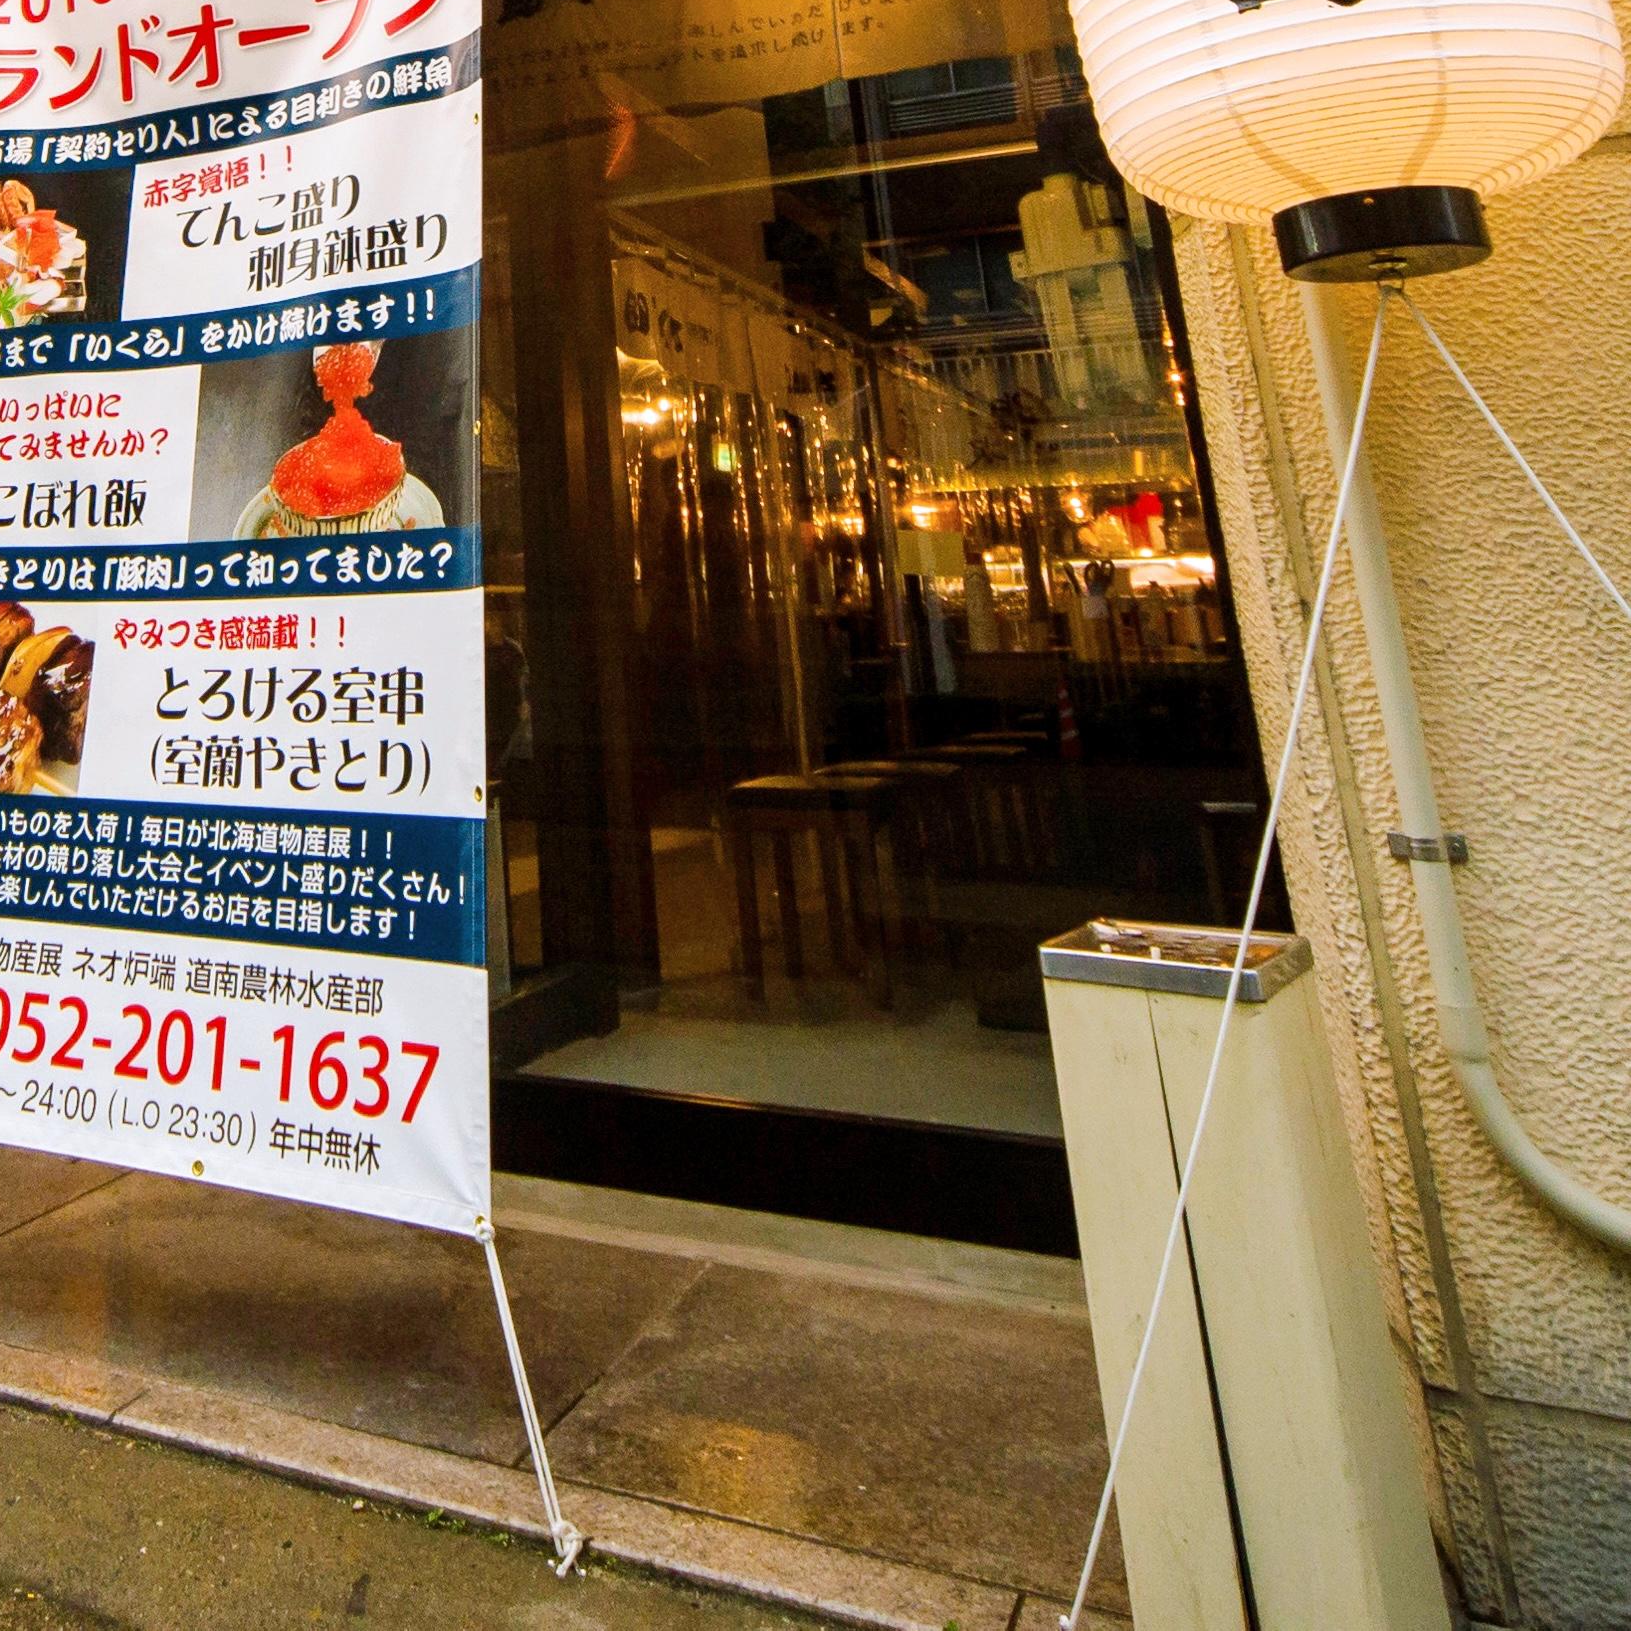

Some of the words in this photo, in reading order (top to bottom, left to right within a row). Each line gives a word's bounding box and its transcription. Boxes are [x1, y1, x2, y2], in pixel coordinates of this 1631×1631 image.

[143, 145, 293, 209] 赤字覚悟！！
[176, 174, 361, 248] てんこ盛り
[246, 213, 448, 293] 刺身鉢盛り
[113, 615, 347, 653] やみつき感満載！！
[154, 666, 425, 727] とろける室串
[72, 946, 177, 993] ネオ炉端
[185, 956, 385, 1017] 道南農林水産部
[269, 1117, 382, 1176] 年中無休
